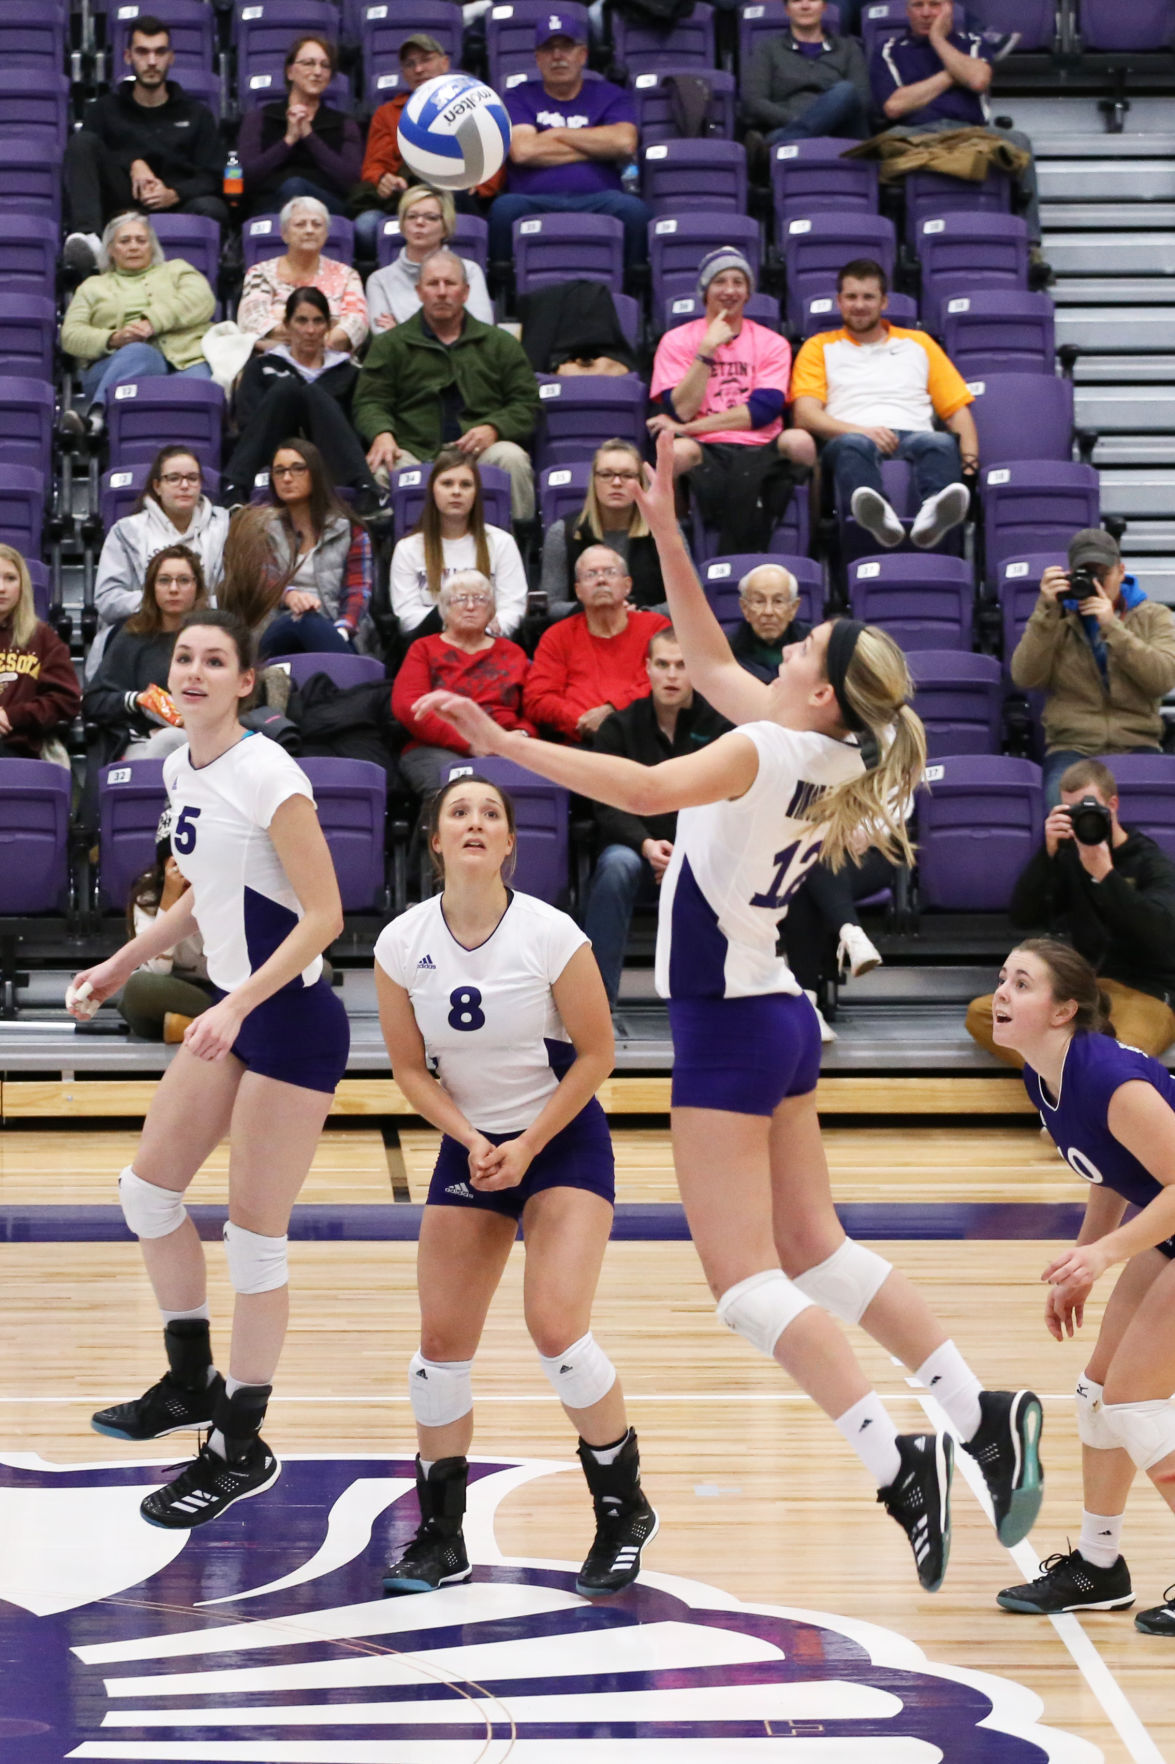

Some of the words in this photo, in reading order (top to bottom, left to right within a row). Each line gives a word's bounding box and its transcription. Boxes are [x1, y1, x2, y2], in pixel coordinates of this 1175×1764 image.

[443, 88, 492, 125] molten
[114, 770, 126, 781] 32
[174, 805, 201, 855] 5
[749, 839, 823, 909] 12
[447, 985, 486, 1032] 8
[1057, 1146, 1104, 1184] 0
